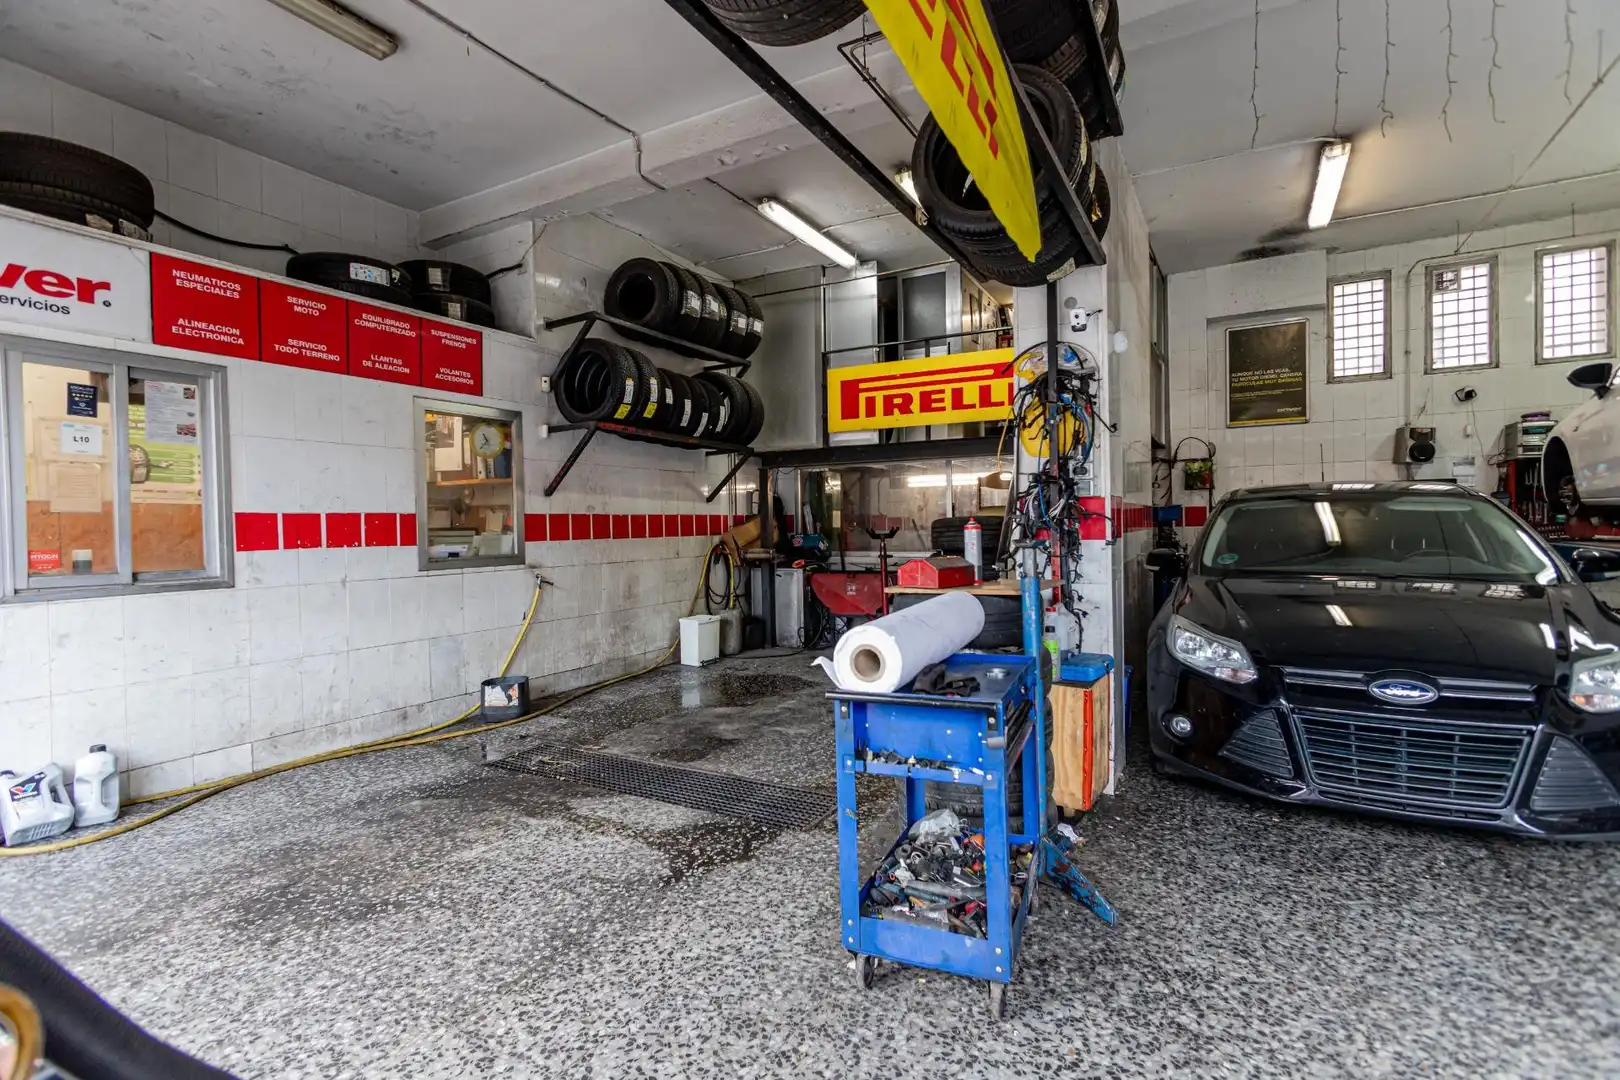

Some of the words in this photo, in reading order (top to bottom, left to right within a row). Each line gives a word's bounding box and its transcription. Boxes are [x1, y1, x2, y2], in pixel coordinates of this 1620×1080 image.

[172, 269, 241, 291] NEUMATICOS
[176, 278, 240, 299] ESPECIALES
[286, 295, 327, 310] SERVICIO
[293, 305, 319, 316] MOTO
[177, 318, 240, 335] ALINEACION
[354, 319, 416, 337] COMPUTERIZADO
[362, 313, 411, 329] EQUILIBRADO
[171, 325, 244, 345] ELECTRONICA
[430, 329, 477, 345] SUSPENSIONES
[287, 338, 327, 351] SERVICIO
[441, 338, 467, 349] FRENOS
[273, 344, 299, 354] TODO
[301, 349, 340, 361] TERRENO
[370, 354, 403, 365] LLANTAS
[374, 362, 410, 374] ALEACION
[439, 367, 471, 378] VOLANTES
[435, 373, 474, 385] ACCESORIOS
